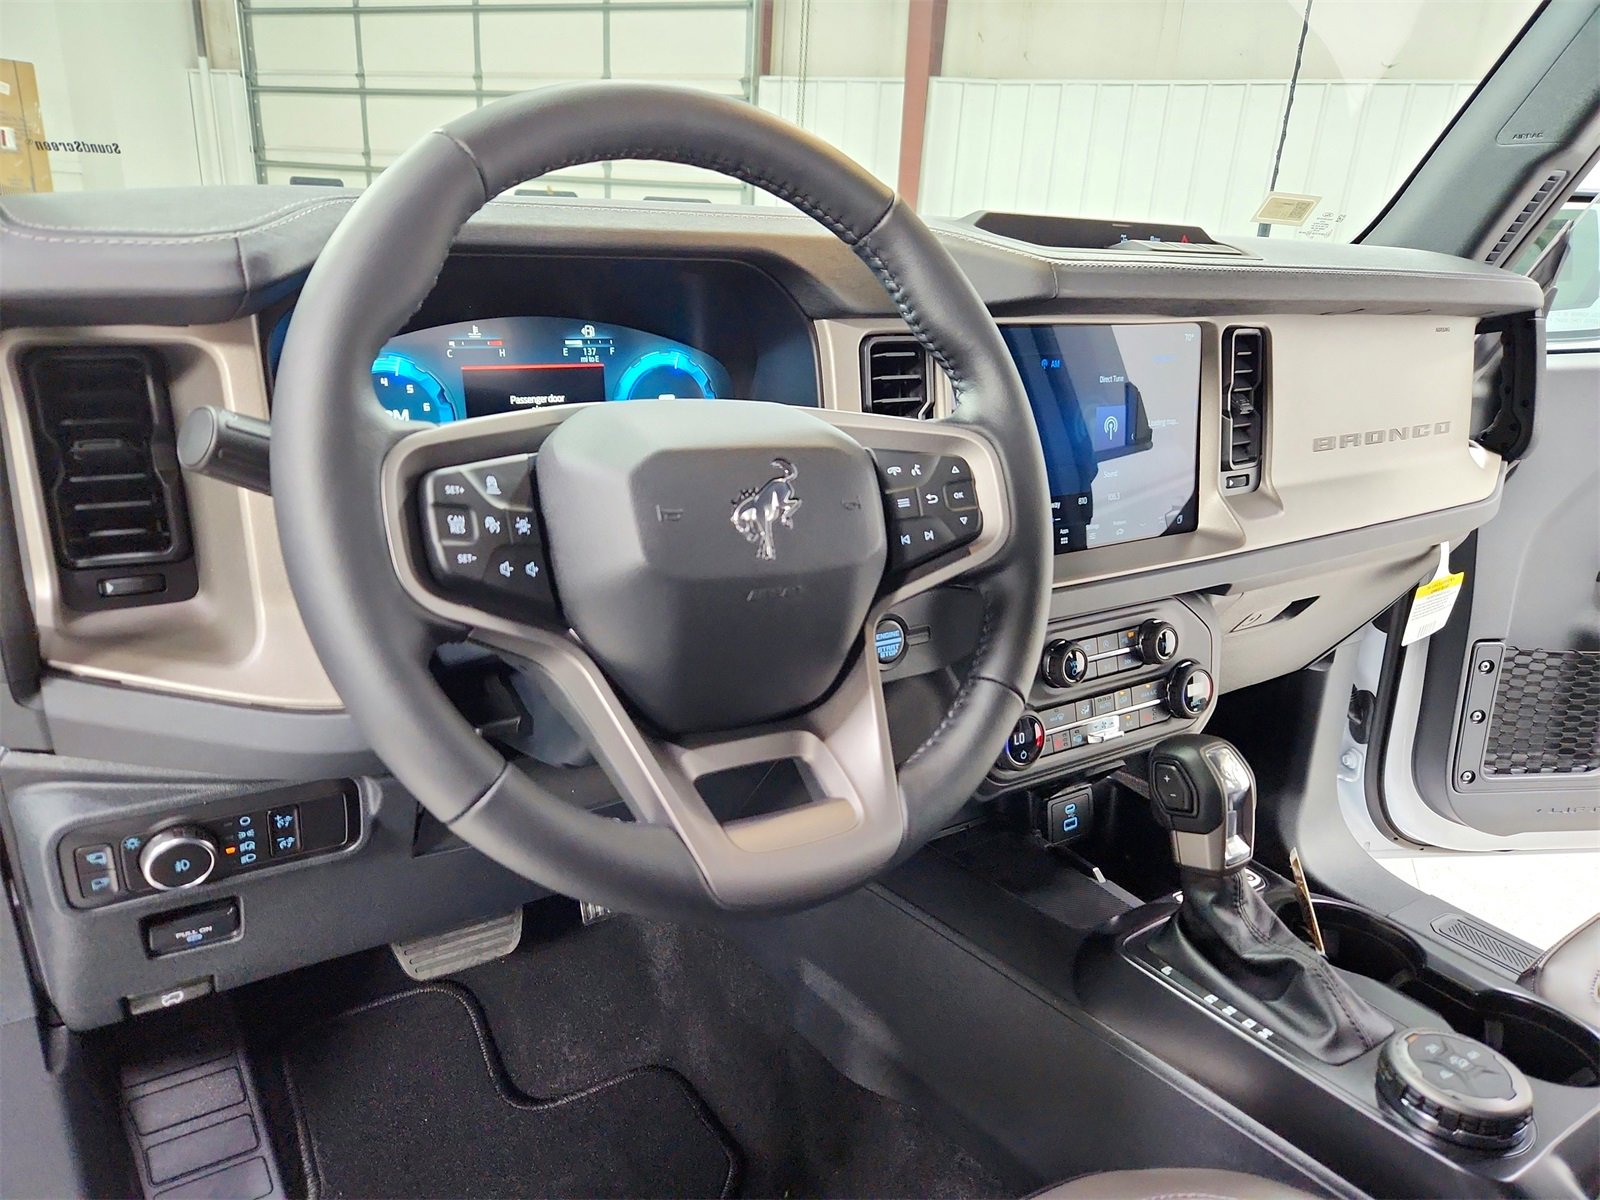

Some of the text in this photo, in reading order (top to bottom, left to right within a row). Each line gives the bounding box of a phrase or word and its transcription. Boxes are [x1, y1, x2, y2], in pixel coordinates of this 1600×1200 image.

[446, 349, 454, 358] C
[499, 348, 506, 358] H
[562, 347, 569, 356] E
[583, 347, 597, 356] 137
[609, 346, 615, 356] F
[380, 377, 389, 387] 4
[406, 384, 414, 394] 5
[510, 393, 566, 406] Passenger door
[423, 402, 431, 412] 6
[1312, 421, 1452, 452] BRONCO
[953, 491, 964, 499] OK
[875, 629, 900, 641] ENGINE
[877, 643, 900, 654] START
[880, 650, 898, 659] STOP
[1013, 732, 1025, 746] LO
[198, 925, 213, 934] ON
